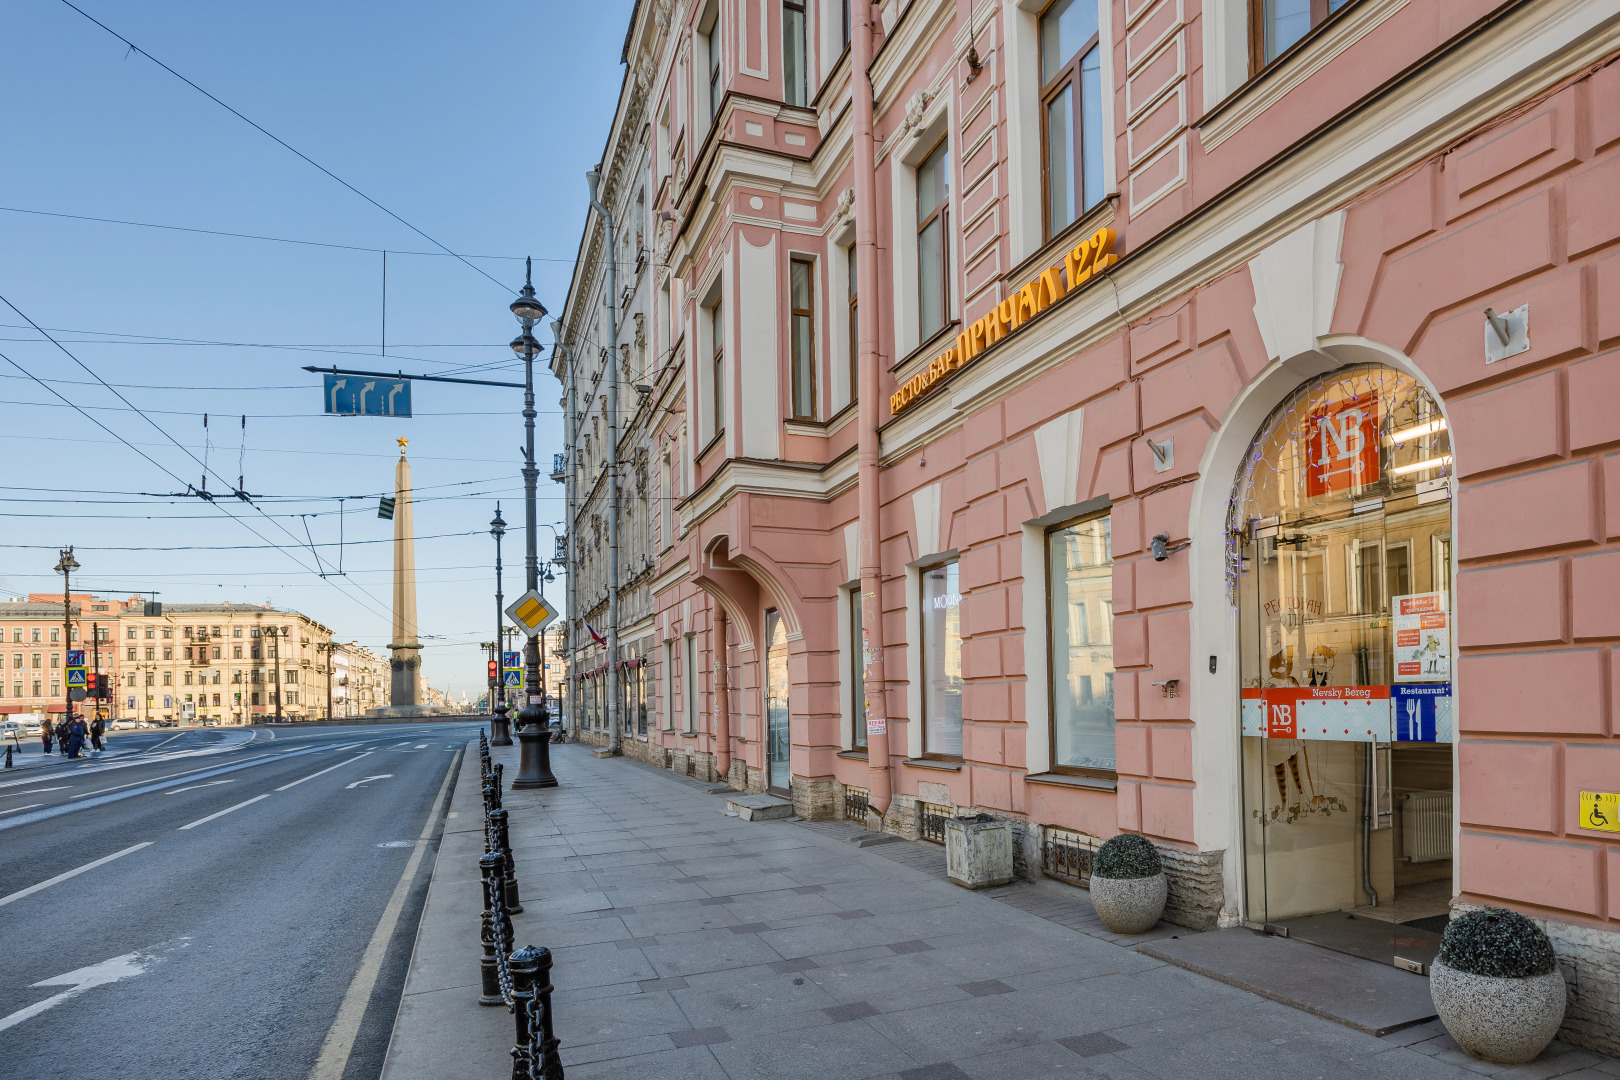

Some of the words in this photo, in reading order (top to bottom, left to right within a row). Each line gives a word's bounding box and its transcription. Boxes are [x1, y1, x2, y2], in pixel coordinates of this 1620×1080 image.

[890, 348, 957, 414] РЕСТО&БАР
[956, 267, 1066, 367] ПРИЧАЛ
[1064, 227, 1118, 293] 122
[1316, 408, 1365, 466] NB
[1312, 688, 1342, 699] Nevsky
[1344, 687, 1371, 698] Bereg
[1400, 687, 1445, 695] Restaurant
[1272, 704, 1292, 726] NB
